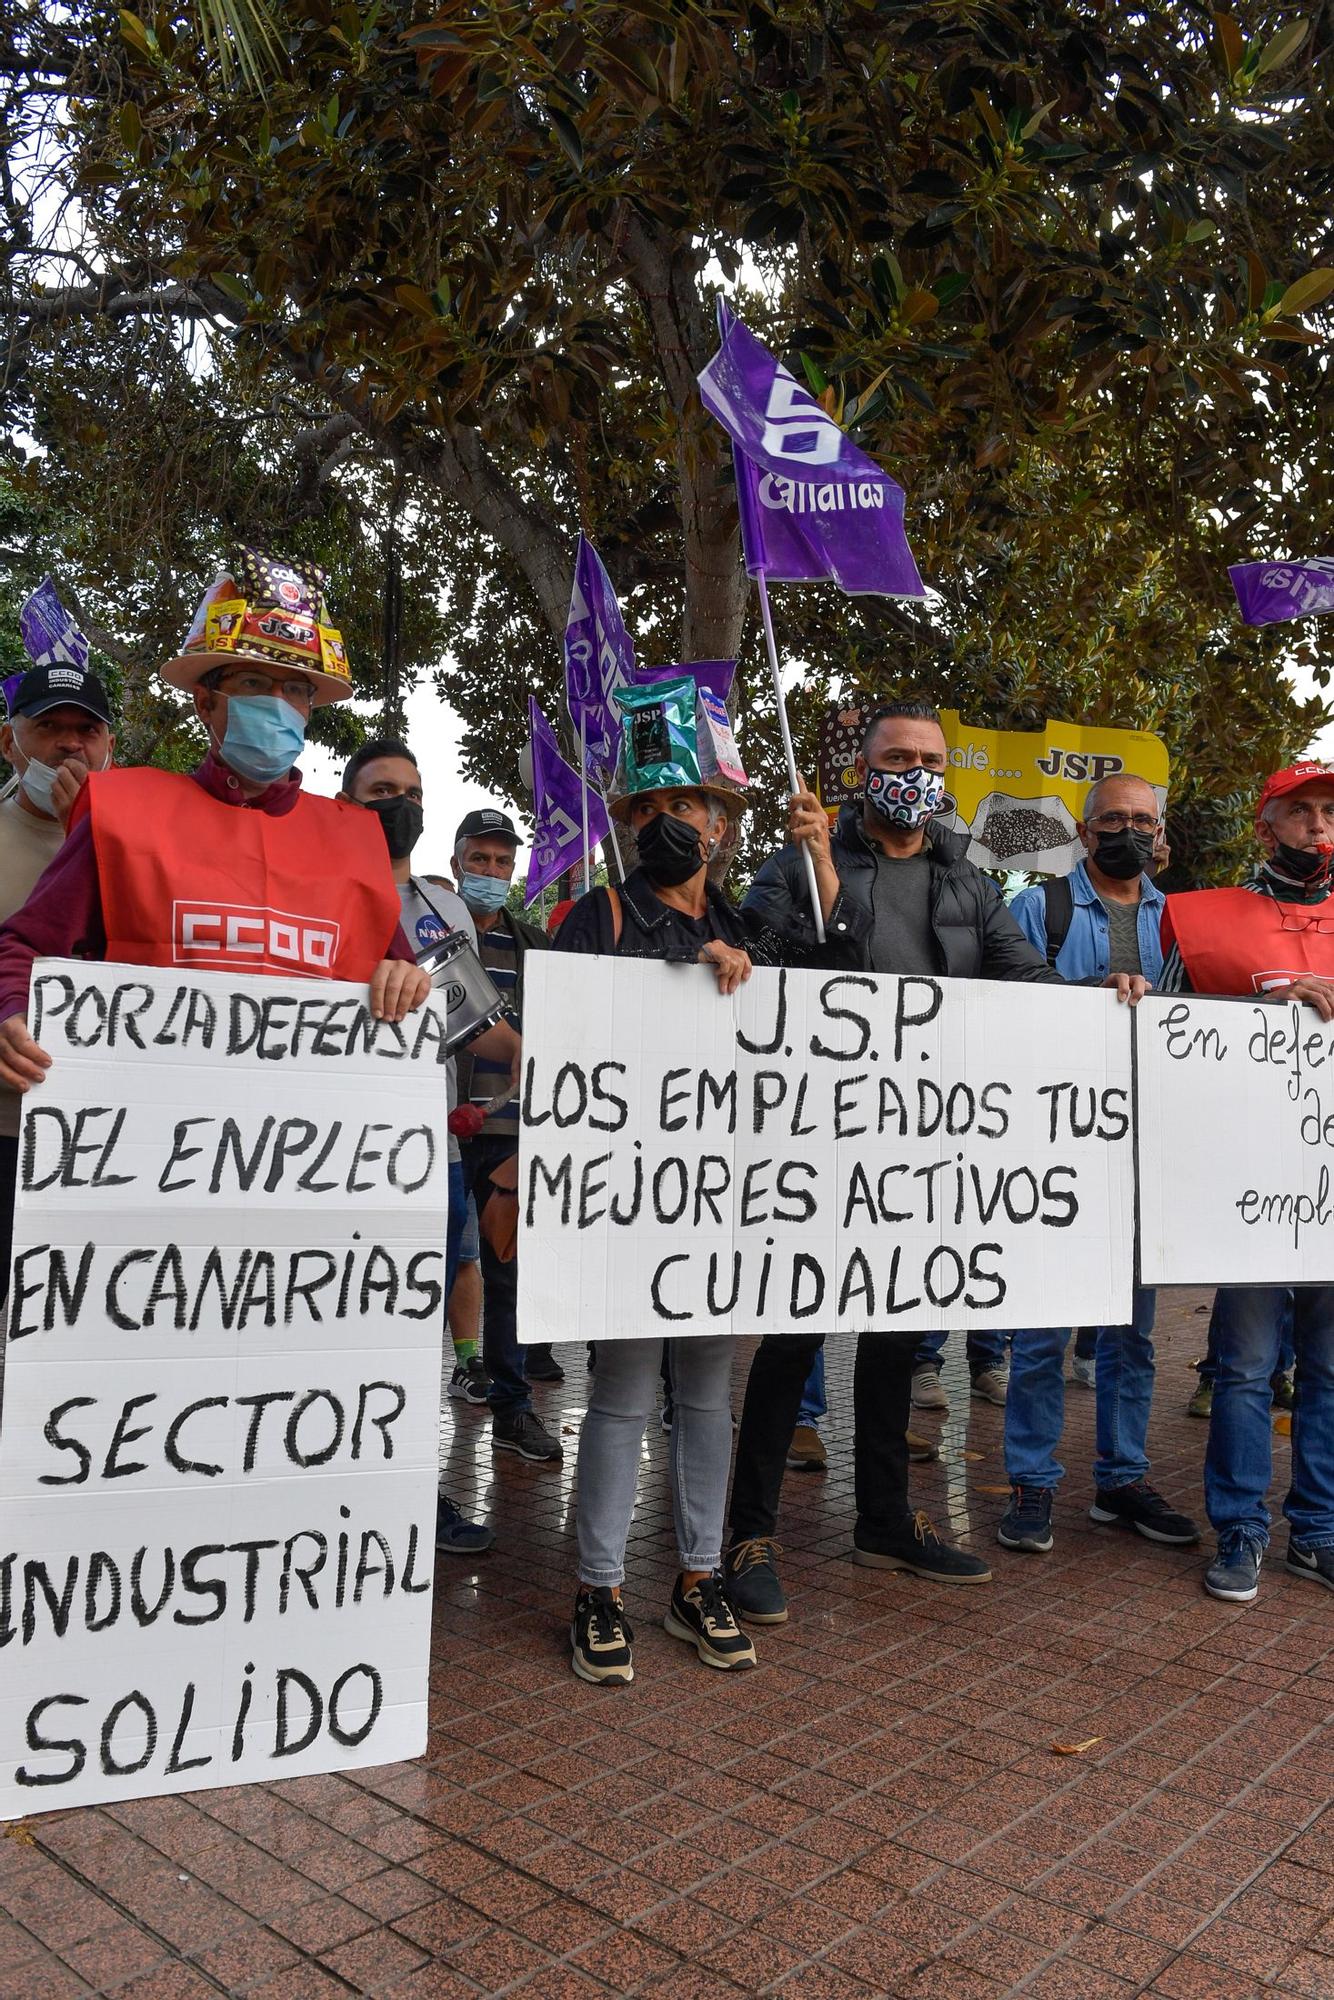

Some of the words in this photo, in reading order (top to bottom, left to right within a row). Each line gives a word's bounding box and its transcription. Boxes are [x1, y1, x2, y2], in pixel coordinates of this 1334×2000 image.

[258, 616, 315, 644] JSP
[50, 670, 82, 682] CCOO
[635, 709, 661, 725] JSP
[1035, 747, 1124, 783] JSP
[182, 913, 334, 968] CCOO
[33, 974, 155, 1049] POR
[153, 986, 217, 1050] LA
[737, 968, 944, 1062] J.S.P.
[1158, 1002, 1228, 1061] En
[522, 1056, 628, 1132] LOS
[659, 1067, 1009, 1140] EMPLEADOS
[1037, 1081, 1130, 1143] TUS
[21, 1107, 138, 1191] DEL
[159, 1115, 436, 1194] ENPLEO
[8, 1241, 96, 1341] EN
[38, 1381, 406, 1485] SECTOR
